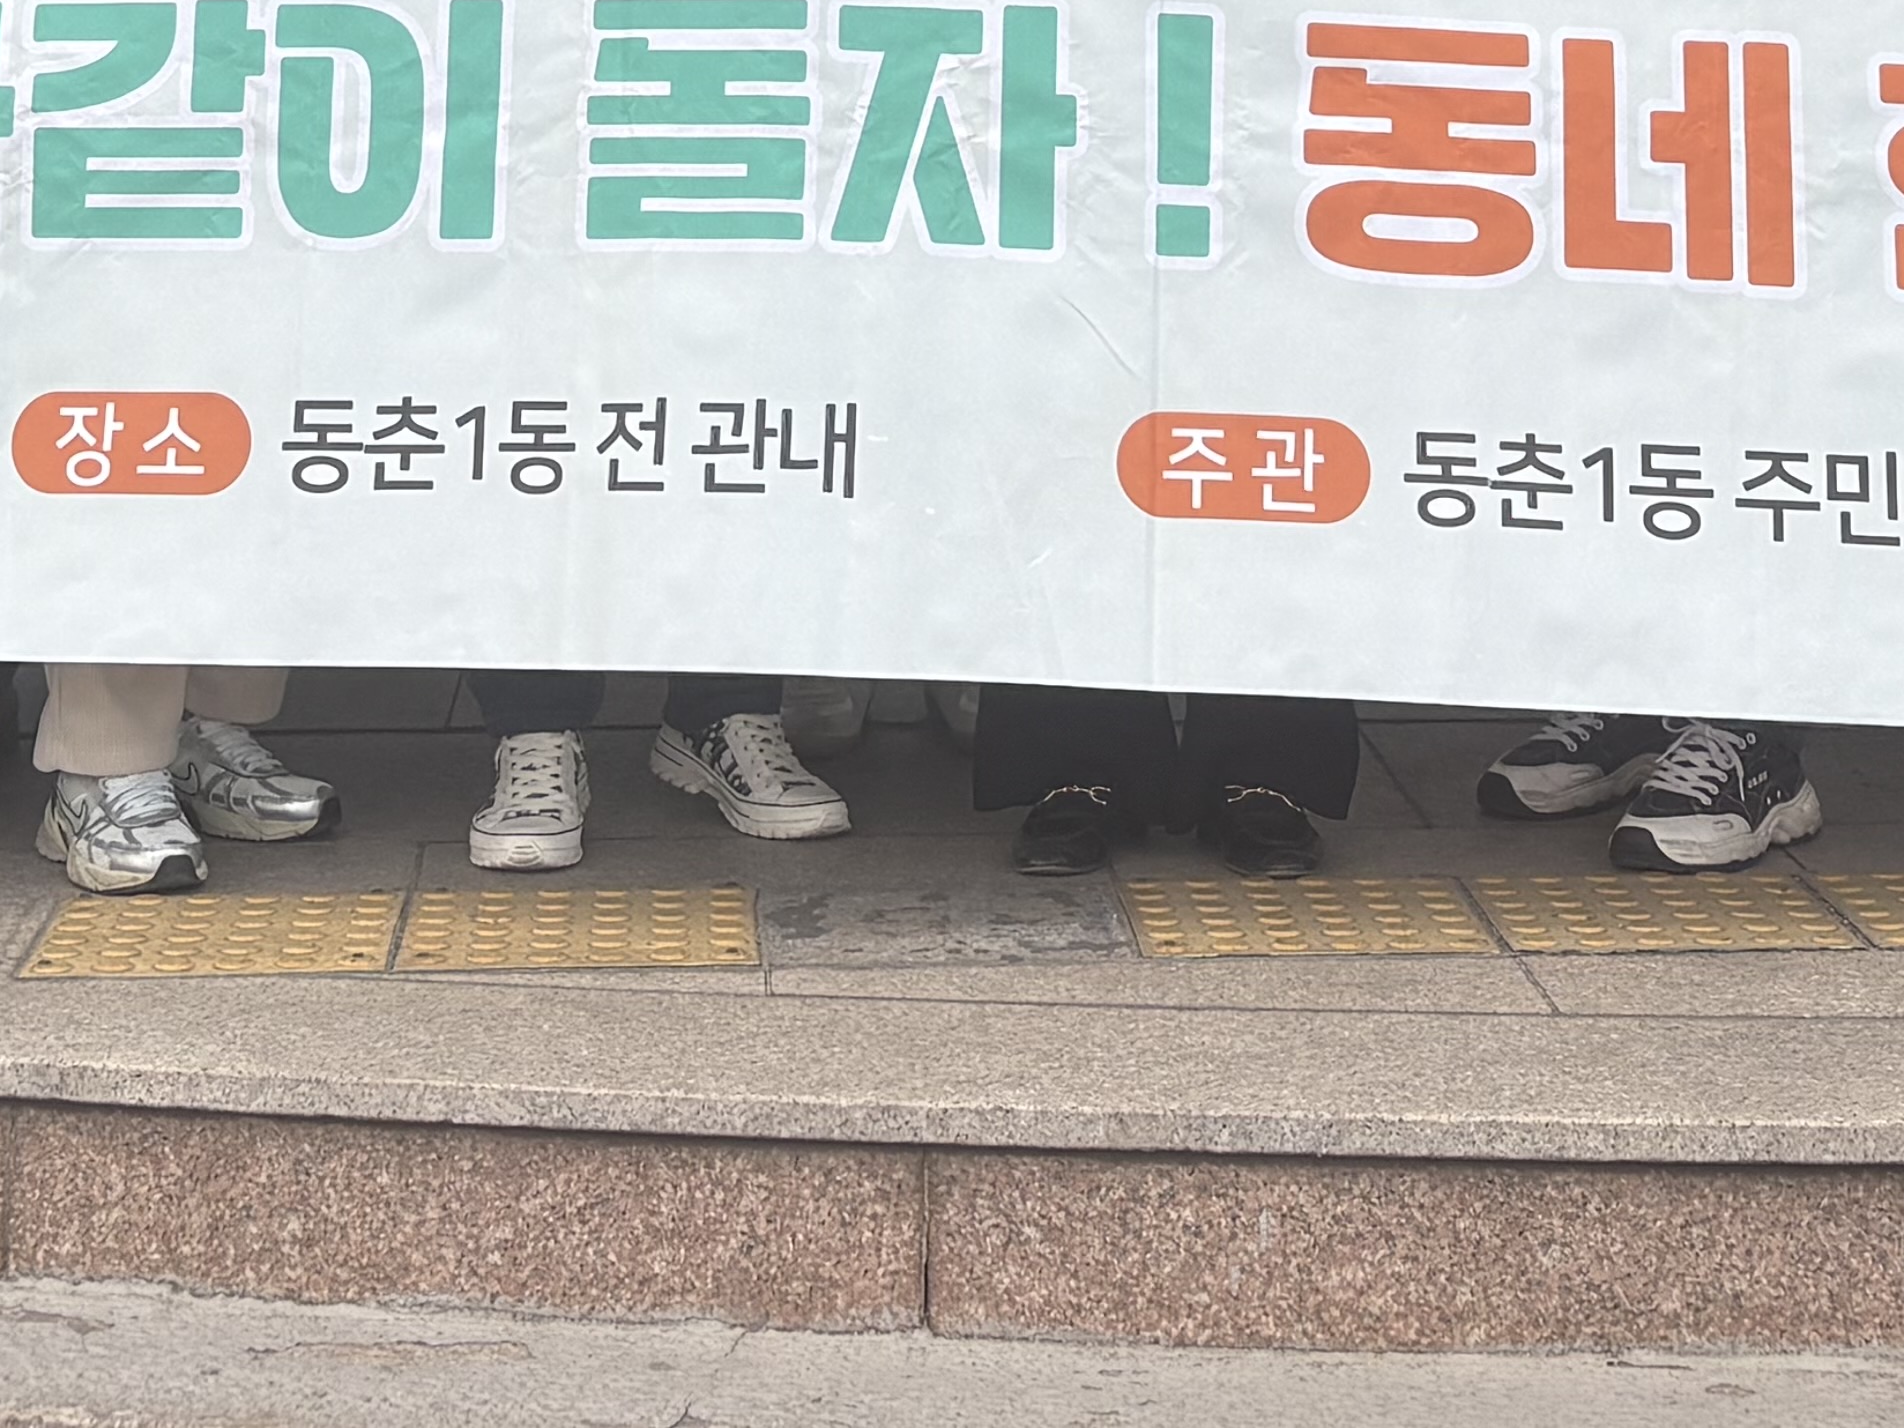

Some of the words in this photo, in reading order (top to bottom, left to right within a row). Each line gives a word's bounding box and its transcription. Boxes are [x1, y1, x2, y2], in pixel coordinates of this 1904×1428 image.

[1302, 20, 1795, 288] 동네
[281, 396, 576, 495] 동춘1동
[1403, 430, 1715, 541] 동춘1동
